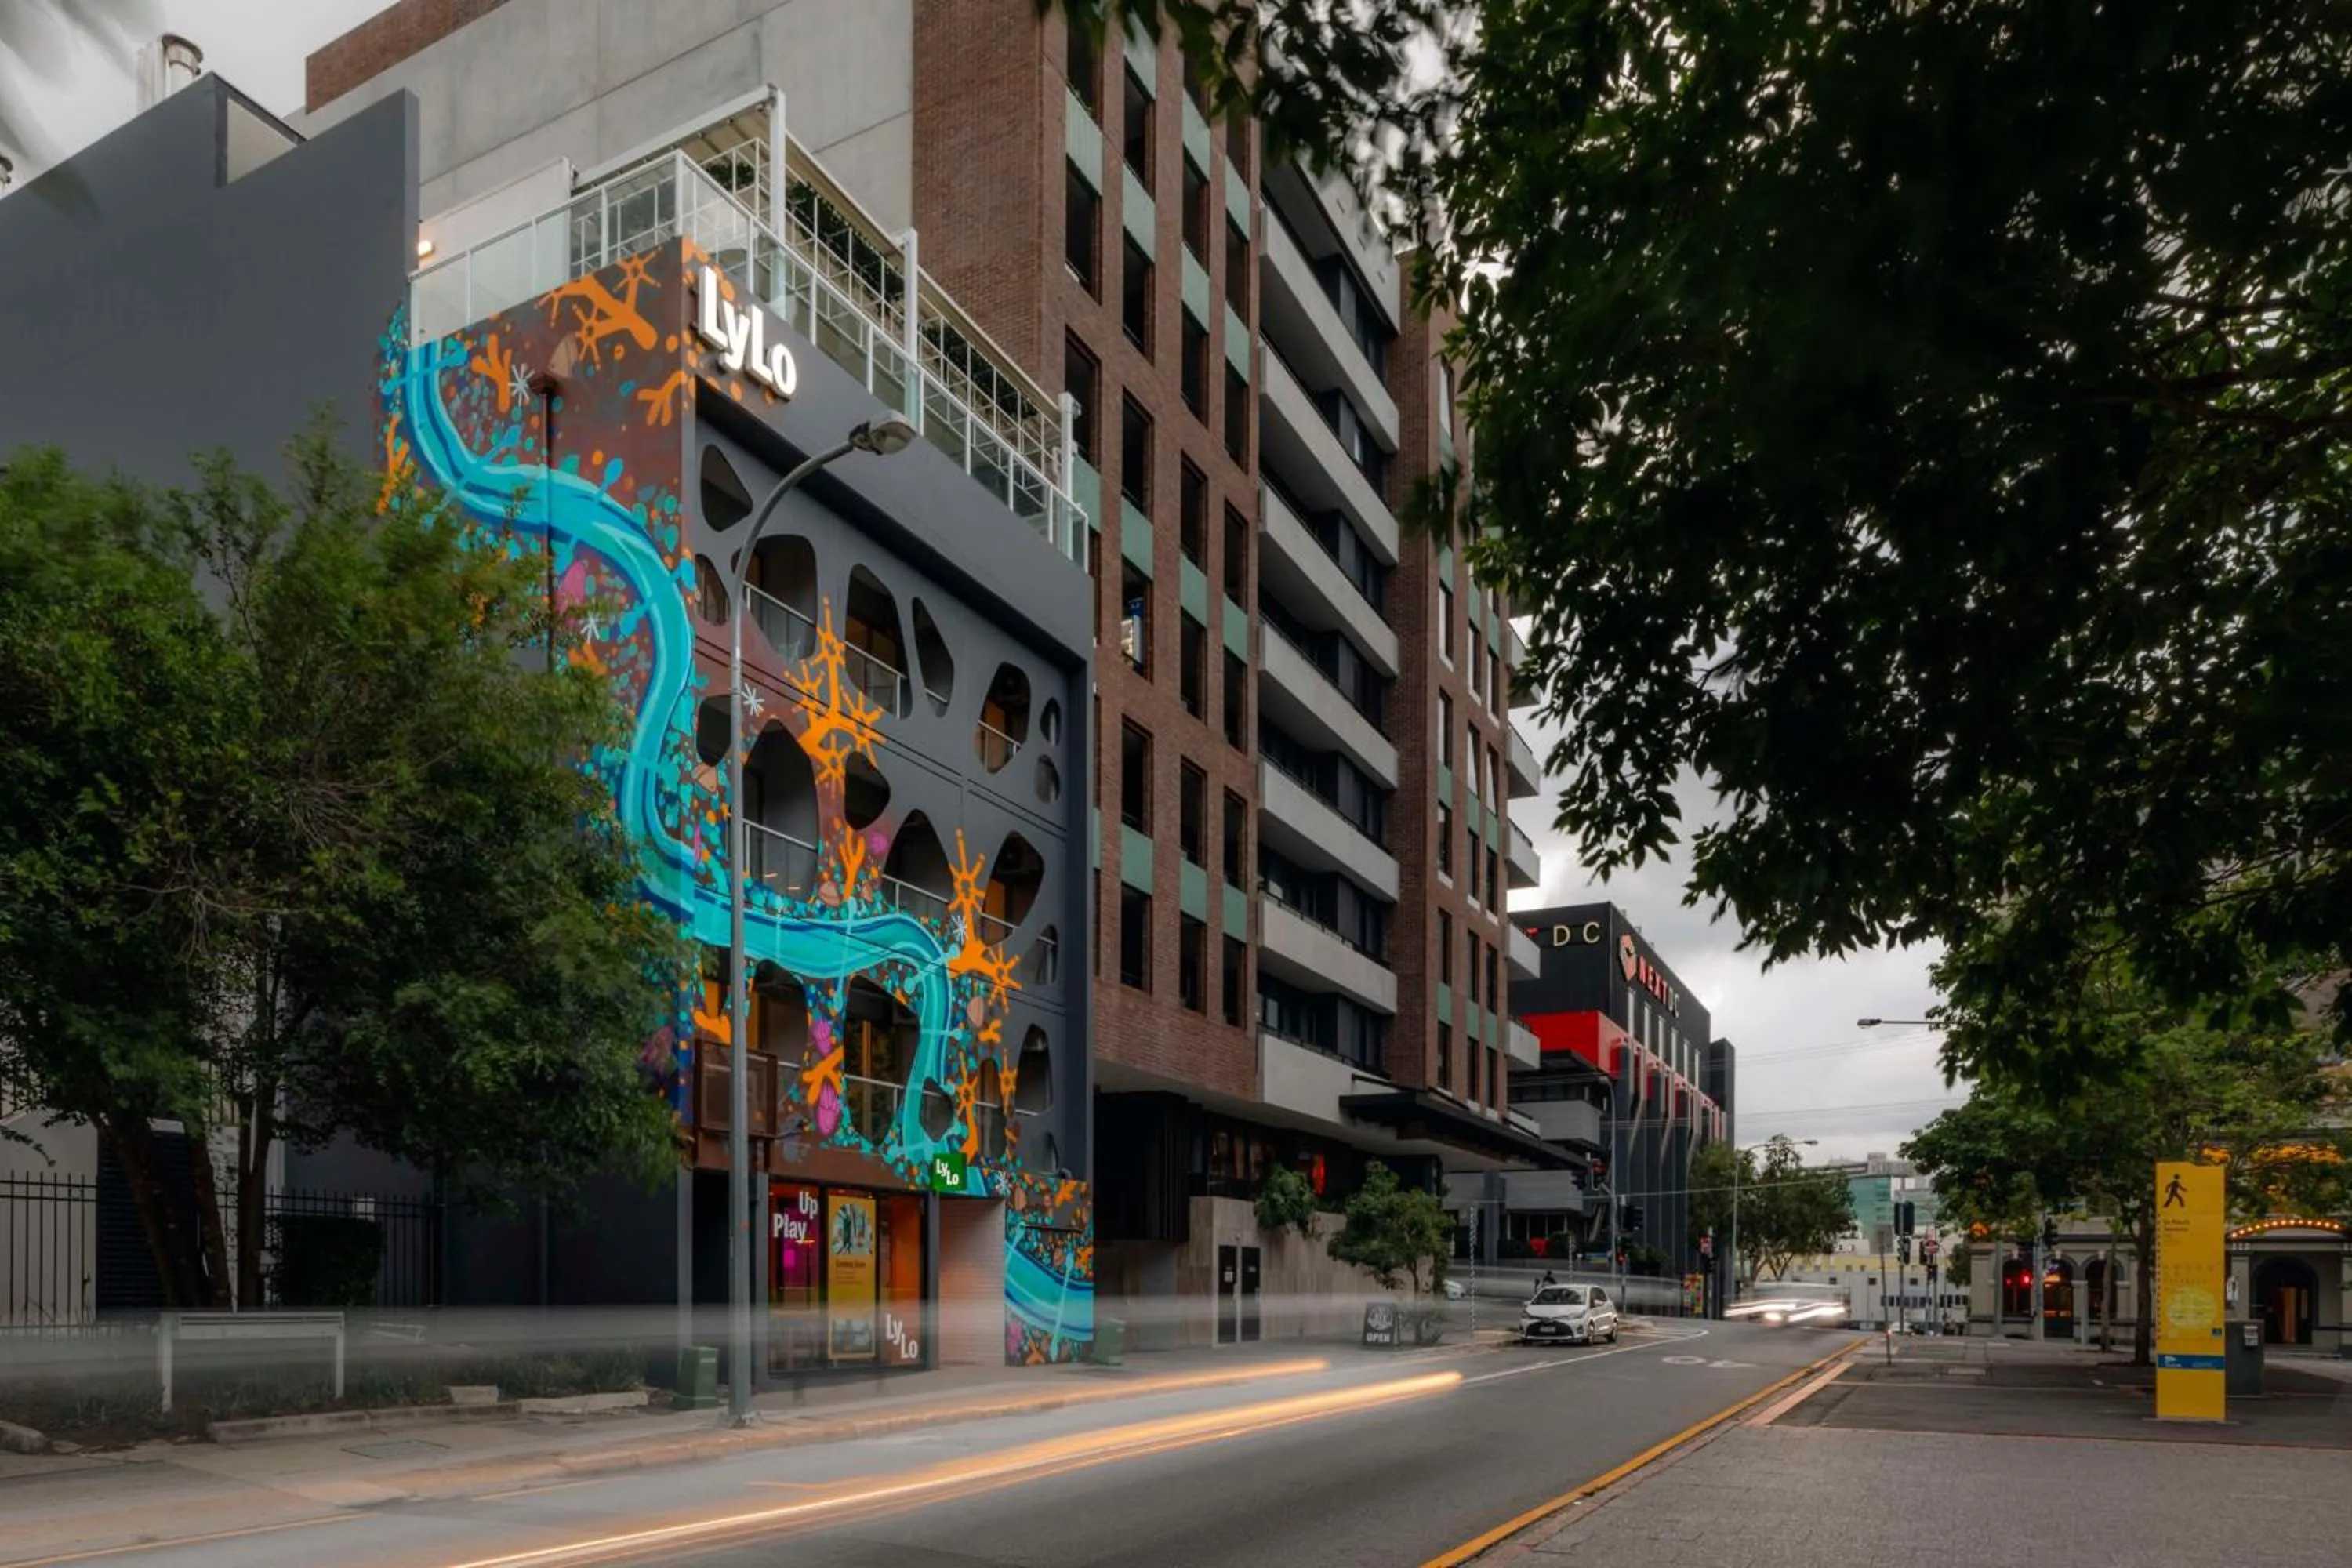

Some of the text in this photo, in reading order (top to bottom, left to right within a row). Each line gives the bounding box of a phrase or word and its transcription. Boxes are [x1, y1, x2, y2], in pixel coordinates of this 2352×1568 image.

[699, 265, 797, 398] LyLo
[799, 1190, 818, 1219] Up
[773, 1213, 808, 1244] Play
[1367, 1332, 1390, 1343] OPEN
